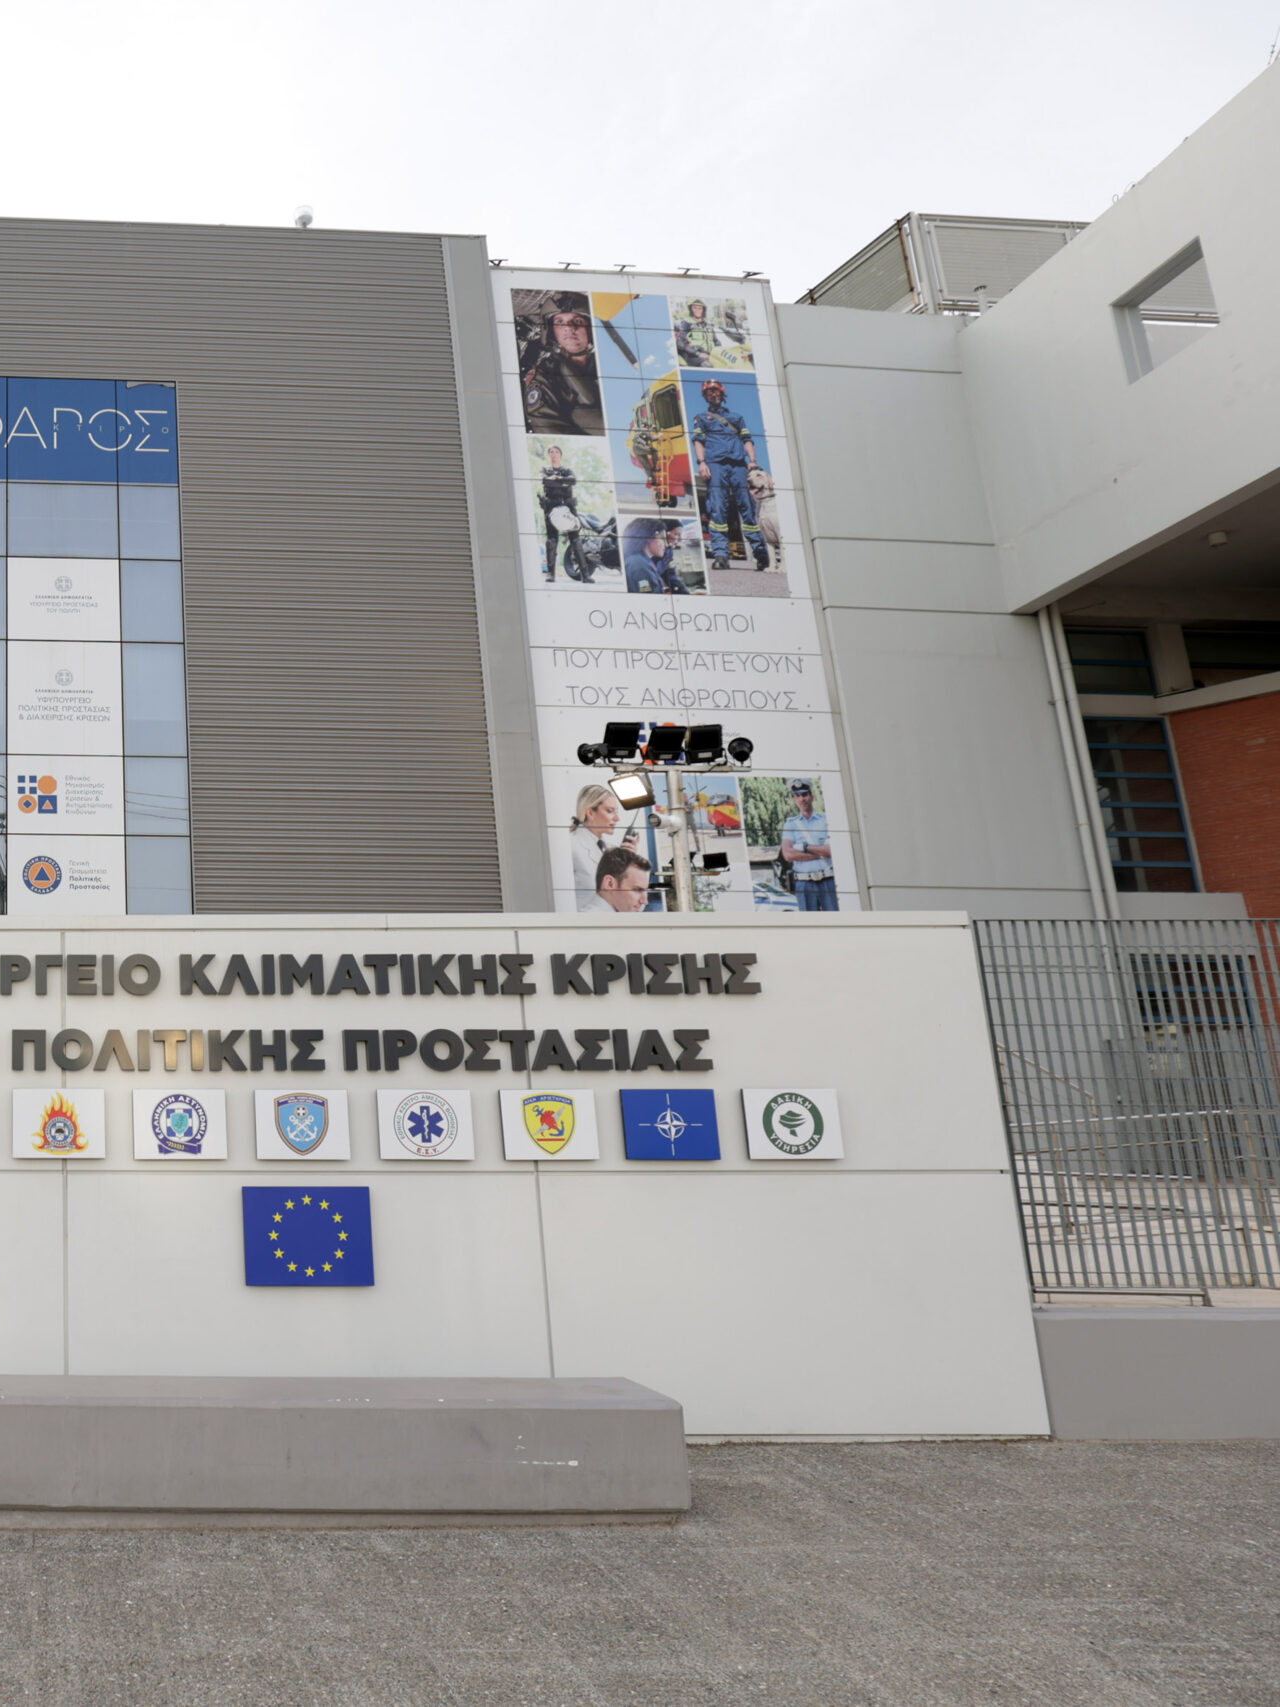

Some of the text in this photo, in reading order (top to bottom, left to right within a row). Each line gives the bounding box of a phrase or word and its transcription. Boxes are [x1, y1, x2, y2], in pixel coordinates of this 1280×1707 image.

[588, 609, 756, 633] ΟΙ ΑΝΘΡΩΠΟΙ
[552, 648, 804, 674] ΠΟΥ ΠΡΟΣΤΑΤΕΥΟΥΝ
[18, 704, 111, 713] ΠΟΛΙΤΙΚΗΣ ΠΡΟΣΤΑΣΙΑΣ
[565, 685, 799, 711] ΤΟΥΣ ΑΝΘΡΩΠΟΥΣ
[26, 713, 74, 721] ΔΙΑΧΕΙΡΙΣΗΣ
[76, 714, 111, 722] ΚΡΙΣΕΩΝ
[69, 875, 102, 883] Πολιτικής
[69, 883, 111, 891] Προστασίας
[179, 953, 537, 996] ΚΛΙΜΑΤΙΚΗΣ
[550, 952, 762, 995] ΚΡΙΣΗΣ
[11, 1028, 326, 1072] ΠΟΛΙΤΙΚΗΣ
[342, 1028, 714, 1072] ΠΡΟΣΤΑΣΙΑΣ
[770, 1094, 813, 1110] ΔΑΣΙΚΗ
[153, 1095, 206, 1140] ΕΛΛΗΝΙΚΗ ΑΣΤΥΝΟΜΙΑ
[769, 1133, 821, 1154] ΥΠΗΡΕΣΙΑ
